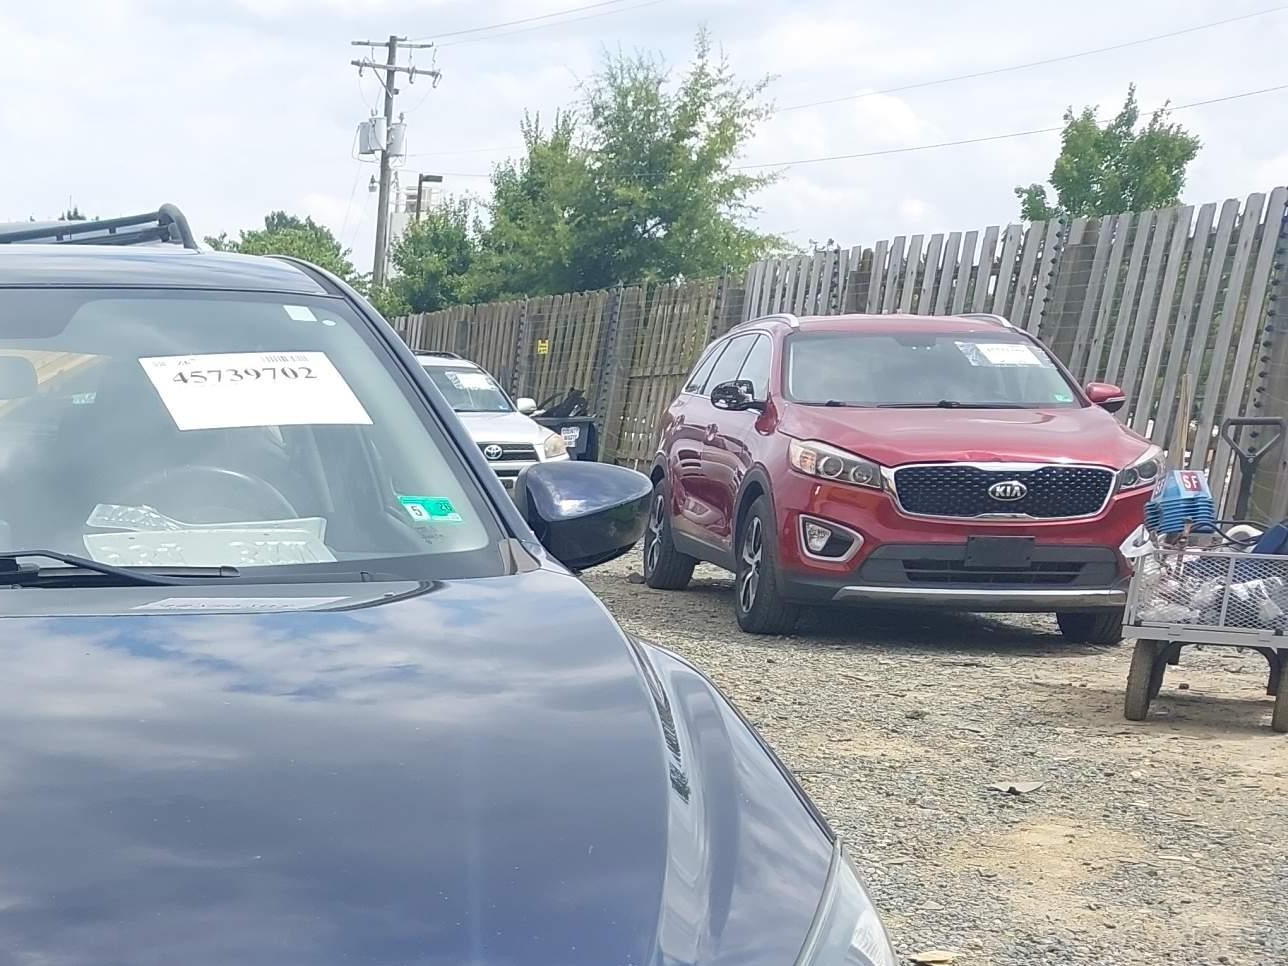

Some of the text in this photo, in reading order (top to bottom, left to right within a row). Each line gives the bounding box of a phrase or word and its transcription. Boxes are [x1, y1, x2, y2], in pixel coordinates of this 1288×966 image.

[172, 366, 318, 384] 45739702
[1182, 474, 1199, 489] SF
[995, 485, 1021, 497] KIA
